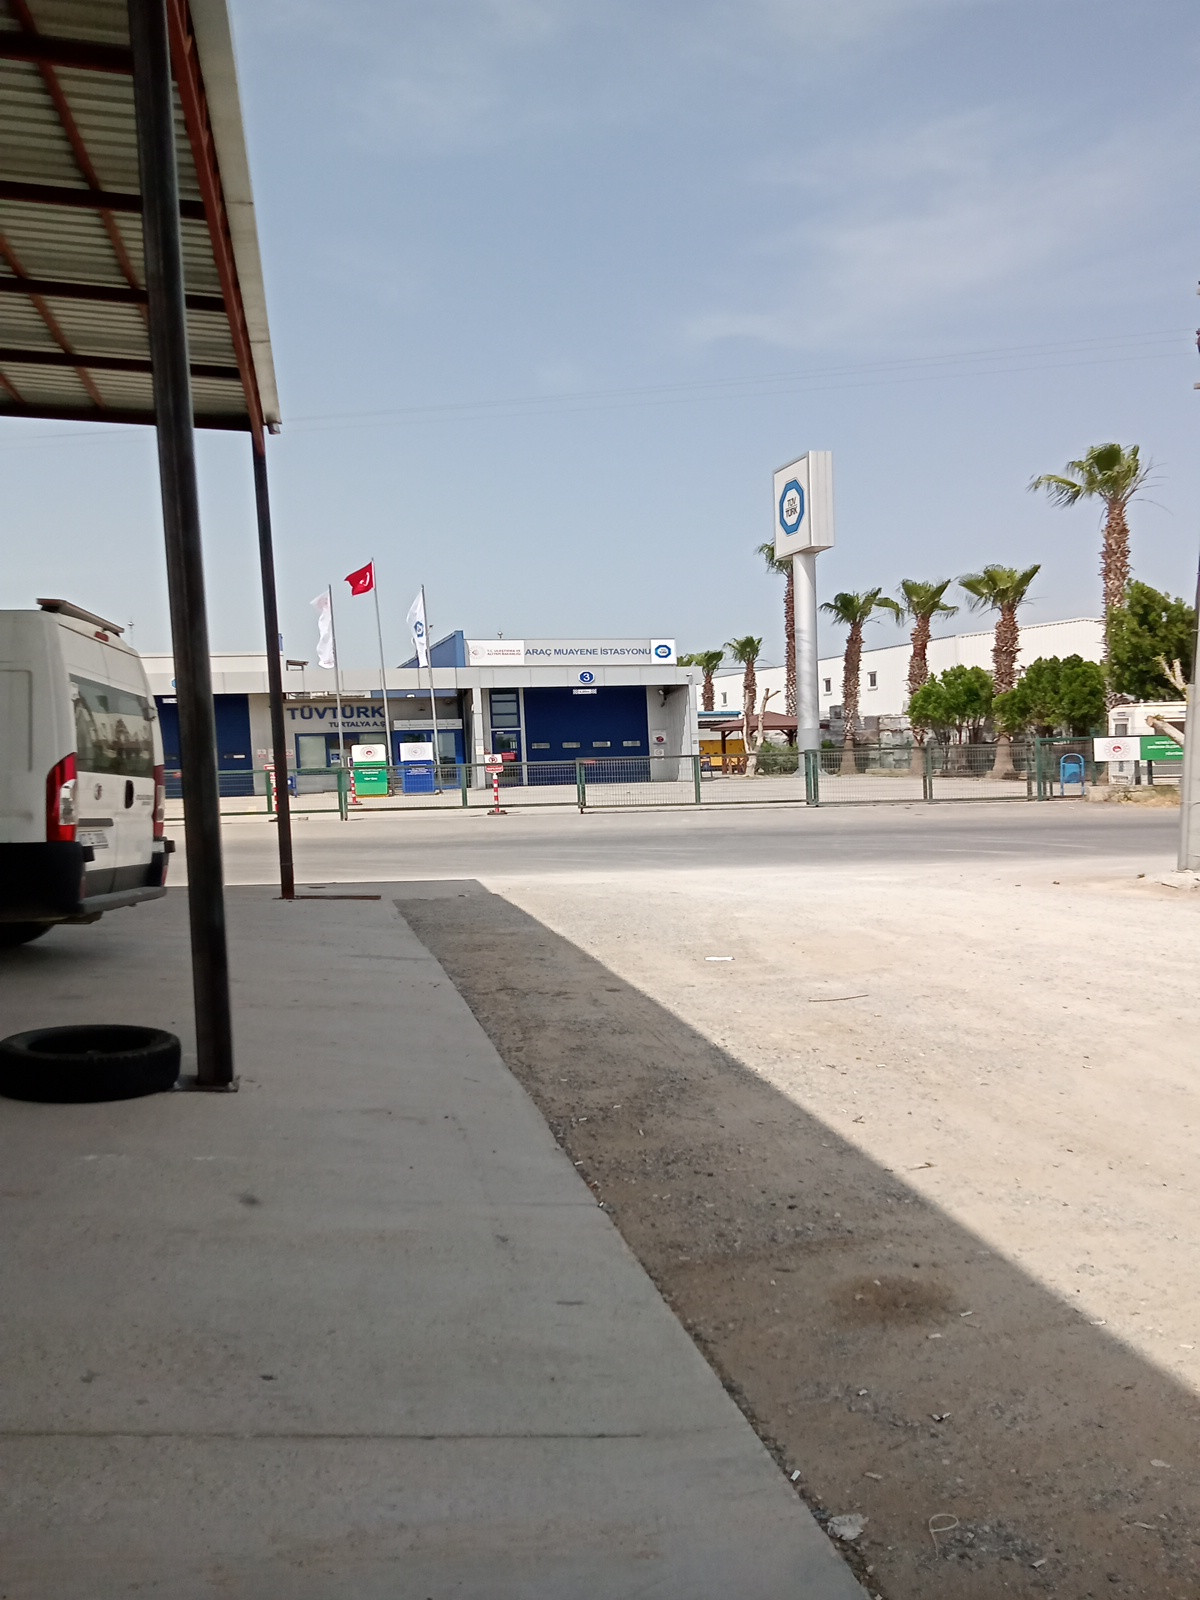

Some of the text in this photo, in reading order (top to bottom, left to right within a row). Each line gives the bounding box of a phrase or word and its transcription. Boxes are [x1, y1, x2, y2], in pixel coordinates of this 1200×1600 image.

[525, 648, 552, 656] ARAÇ
[600, 646, 651, 655] İSTASYONU
[583, 673, 590, 681] 3
[286, 704, 385, 720] TÜVTÜRK
